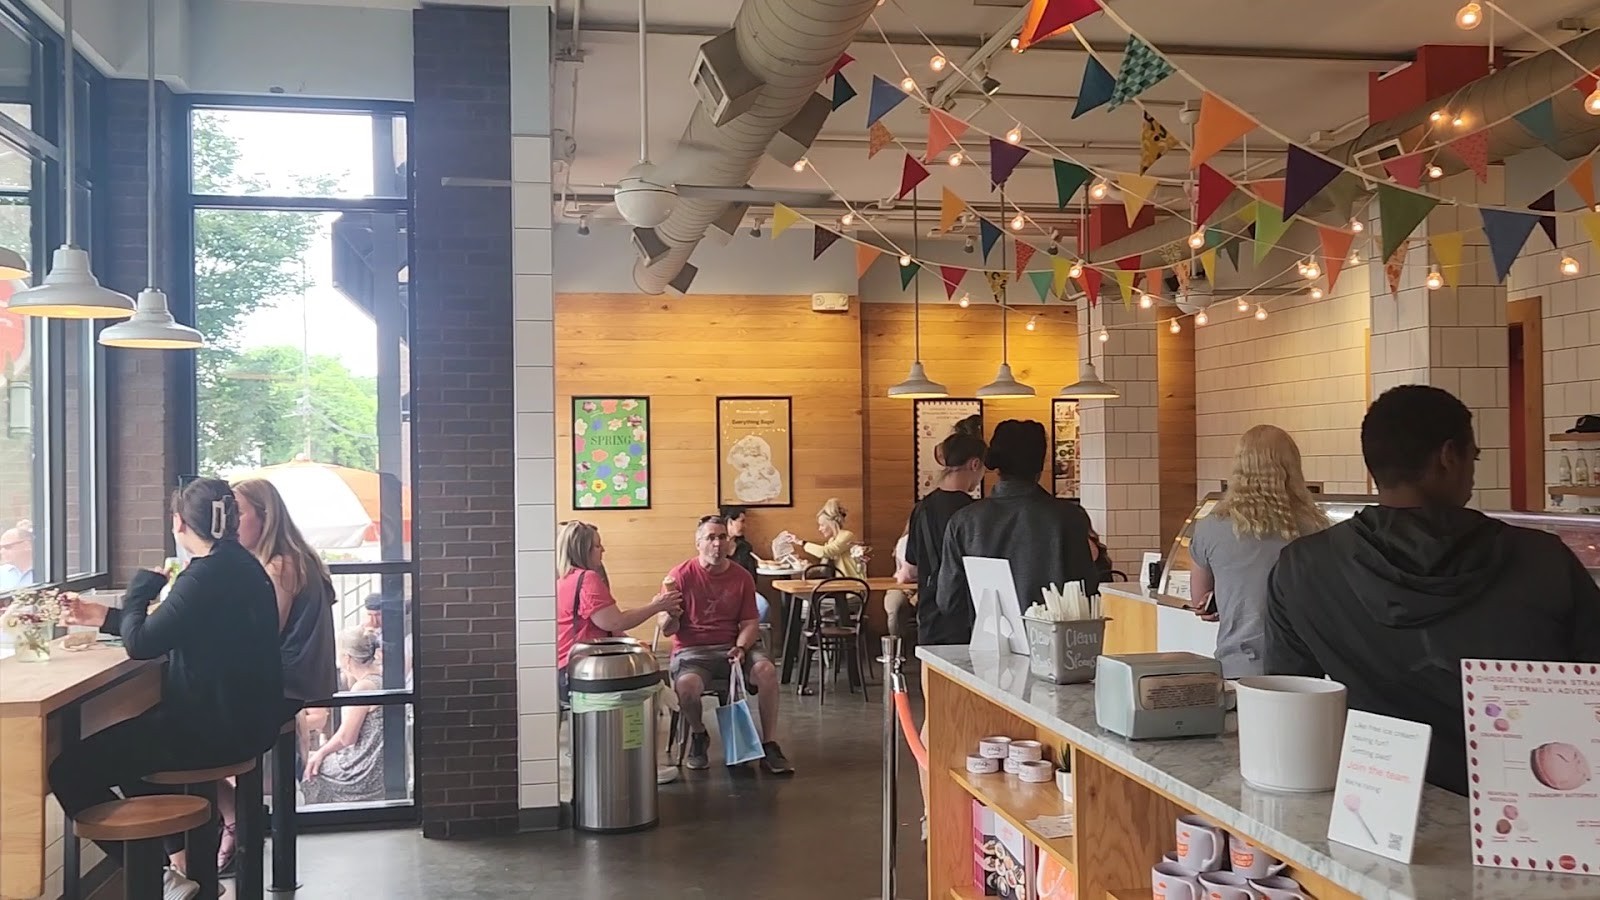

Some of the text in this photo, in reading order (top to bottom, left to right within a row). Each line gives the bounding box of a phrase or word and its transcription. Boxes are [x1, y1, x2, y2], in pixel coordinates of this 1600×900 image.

[590, 435, 632, 446] SPRING
[1066, 629, 1098, 648] Clean
[1476, 675, 1514, 683] CHOOSE
[1493, 684, 1553, 693] BUTTERMILK
[1368, 765, 1384, 776] the
